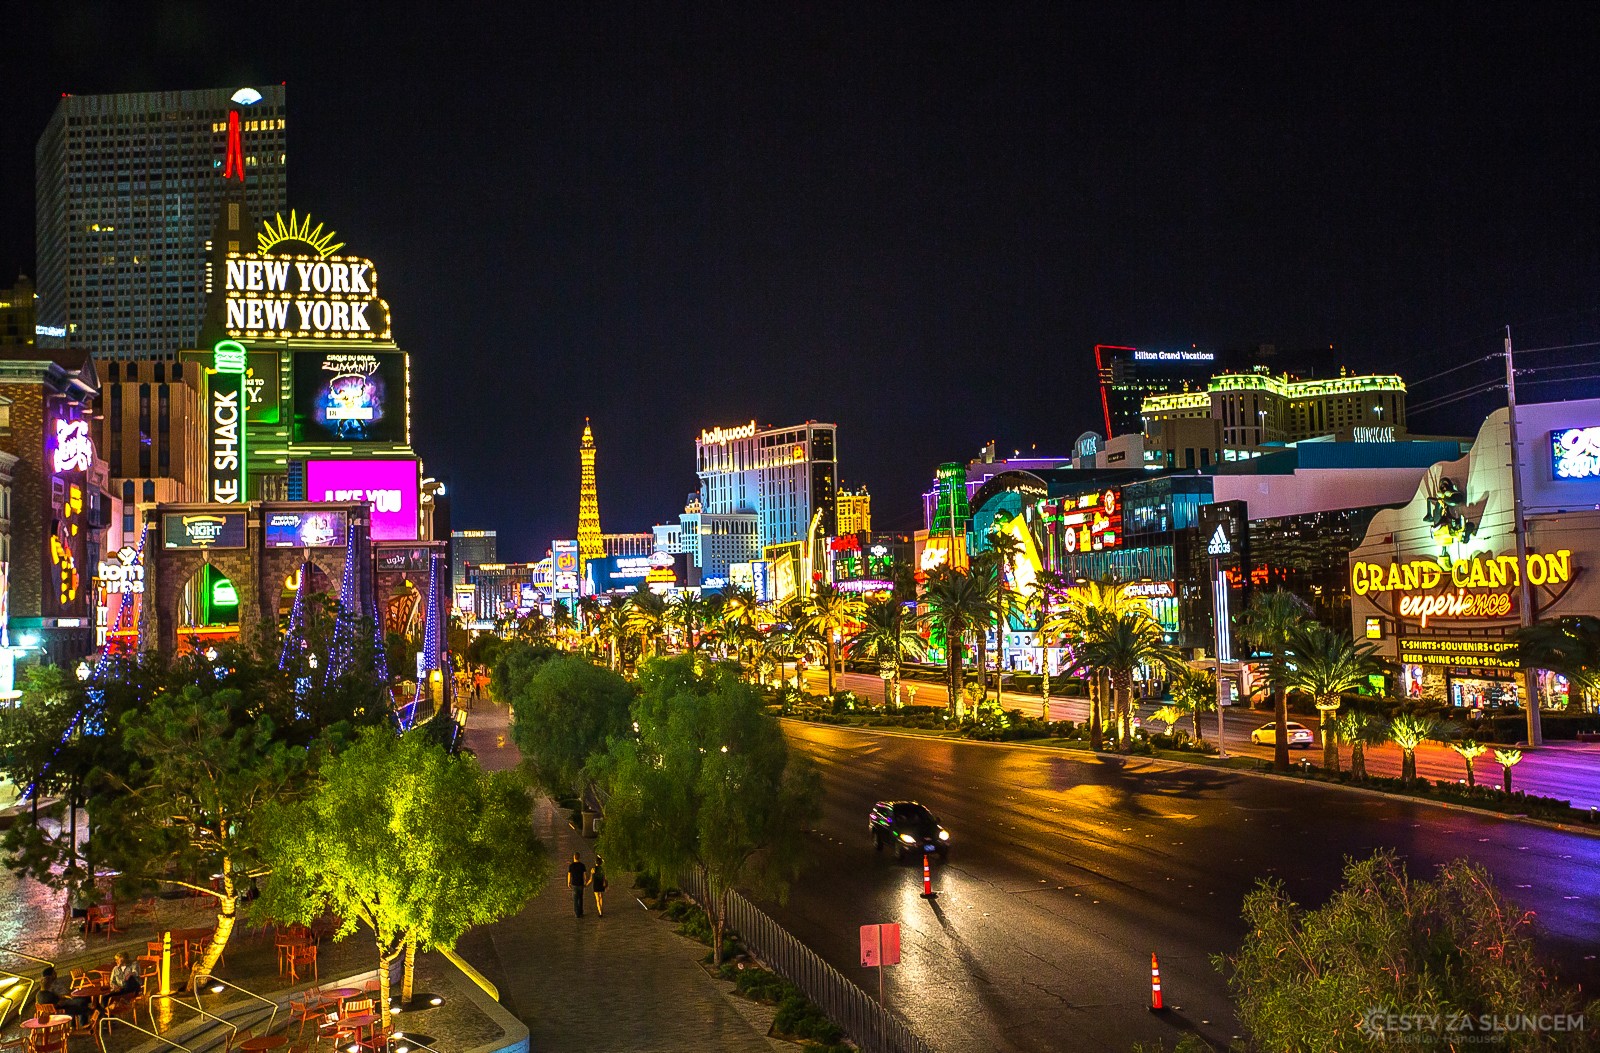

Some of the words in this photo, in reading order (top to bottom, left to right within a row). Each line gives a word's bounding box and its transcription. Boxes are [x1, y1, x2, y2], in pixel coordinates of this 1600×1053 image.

[226, 260, 290, 291] NEW
[295, 262, 370, 293] YORK
[226, 298, 290, 329] NEW
[295, 301, 370, 331] YORK
[1135, 351, 1158, 359] Hilton
[1159, 351, 1180, 359] Grand
[1181, 351, 1214, 360] Vacations
[322, 361, 380, 376] ZUMANITY
[214, 391, 238, 471] SHACK
[702, 420, 756, 446] hollywood
[1354, 427, 1395, 443] SHOWCASE
[366, 490, 401, 512] YOU
[186, 525, 222, 536] NIGHT
[1208, 541, 1230, 554] adidas
[386, 555, 405, 565] ugly
[98, 561, 144, 581] tom
[1352, 561, 1442, 595] GRAND
[1400, 588, 1511, 628] experience
[1401, 641, 1437, 650] T-SHIRTS
[1440, 642, 1488, 651] SOUVENIRS
[1402, 654, 1423, 663] BEER
[1427, 655, 1450, 664] WINE
[1454, 656, 1478, 666] SODA
